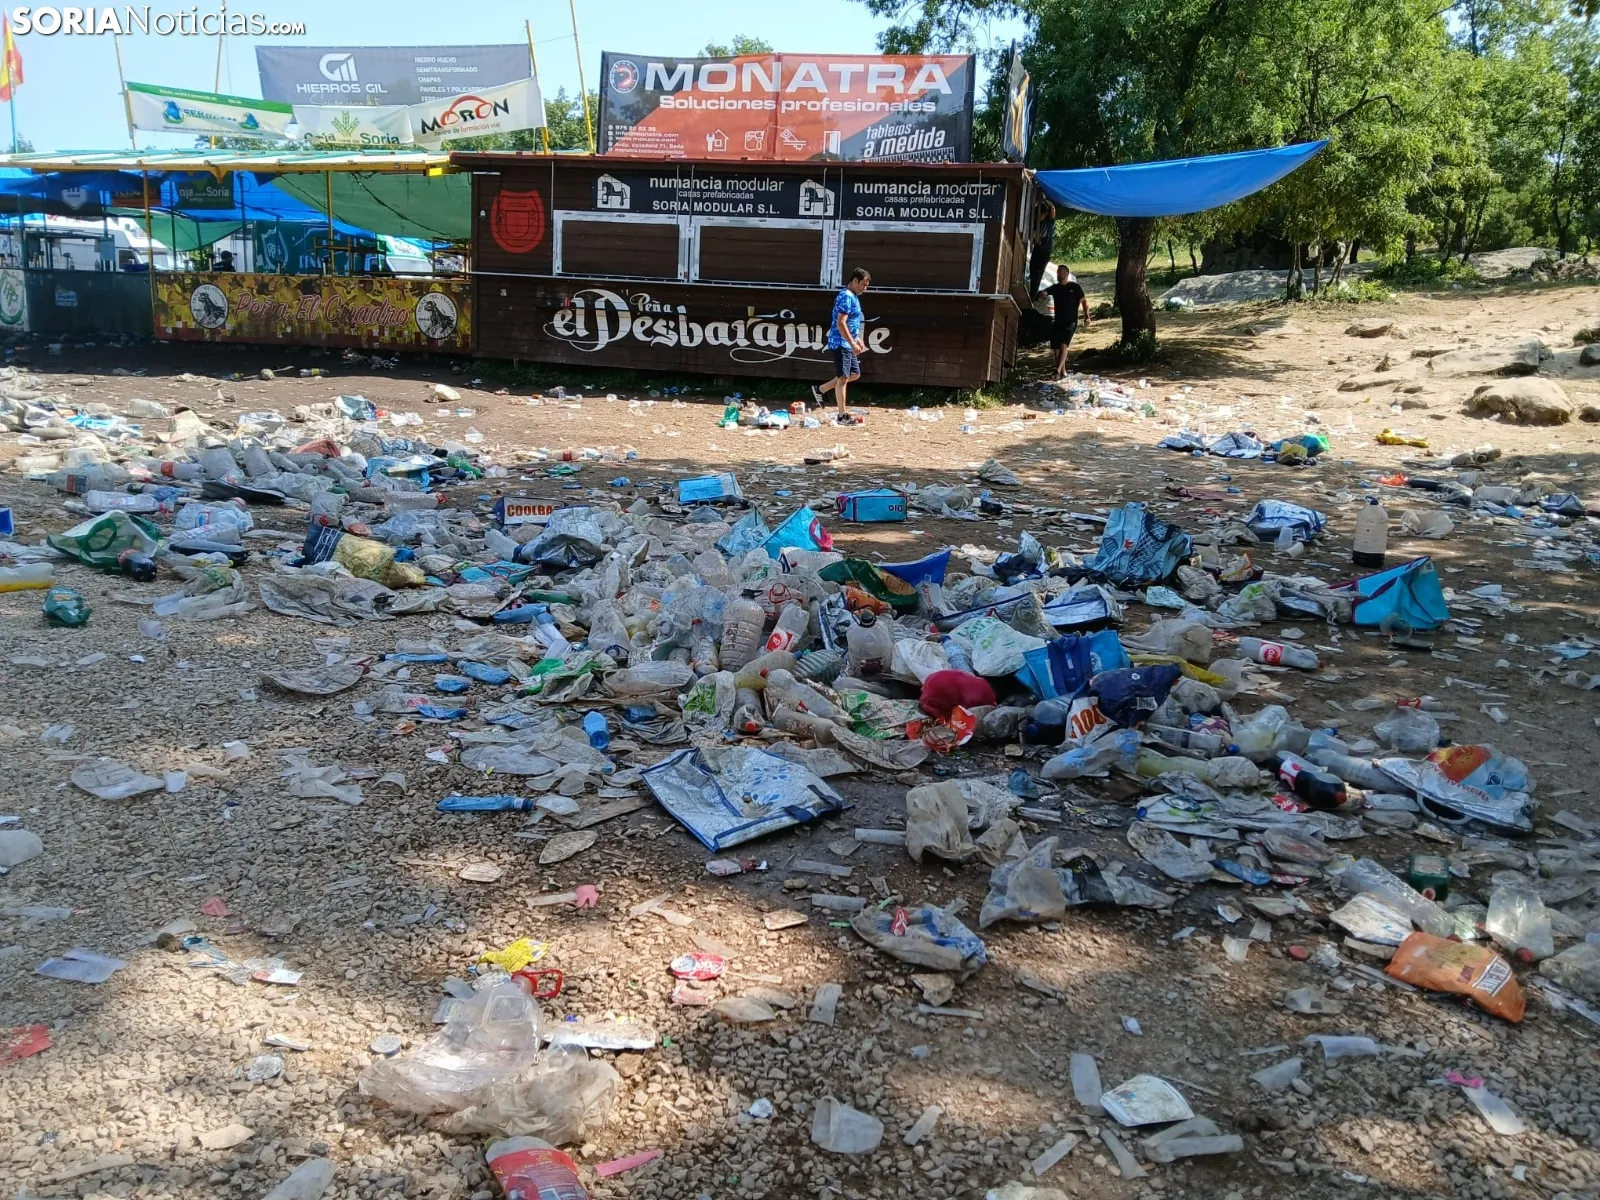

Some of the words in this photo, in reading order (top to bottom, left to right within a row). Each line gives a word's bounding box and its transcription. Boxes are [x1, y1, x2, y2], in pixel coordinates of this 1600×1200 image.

[645, 62, 952, 94] MONATRA
[296, 84, 361, 94] HIERROS
[365, 84, 388, 94] GIL
[659, 95, 776, 110] Soluciones
[781, 97, 936, 113] profesionales
[460, 122, 490, 132] formación
[490, 121, 501, 129] vial
[866, 123, 912, 140] tableros
[360, 132, 401, 145] Soria
[863, 141, 875, 158] a
[879, 126, 946, 156] medida
[206, 186, 230, 197] Soria
[650, 176, 722, 190] numancia
[726, 177, 784, 192] modular
[853, 180, 931, 195] numancia
[935, 181, 997, 196] modular
[678, 190, 701, 199] casas
[702, 190, 754, 200] prefabricadas
[884, 195, 908, 203] casas
[910, 194, 965, 205] prefabricadas
[652, 200, 690, 211] SORIA
[693, 202, 754, 214] MODULAR
[757, 205, 780, 215] S.L.
[856, 206, 895, 218] SORIA
[899, 207, 964, 219] MODULAR
[968, 208, 993, 219] S.L.
[296, 294, 322, 324] El
[324, 294, 410, 327] Cuadro
[630, 292, 673, 314] Peña
[507, 504, 560, 517] COOLBA
